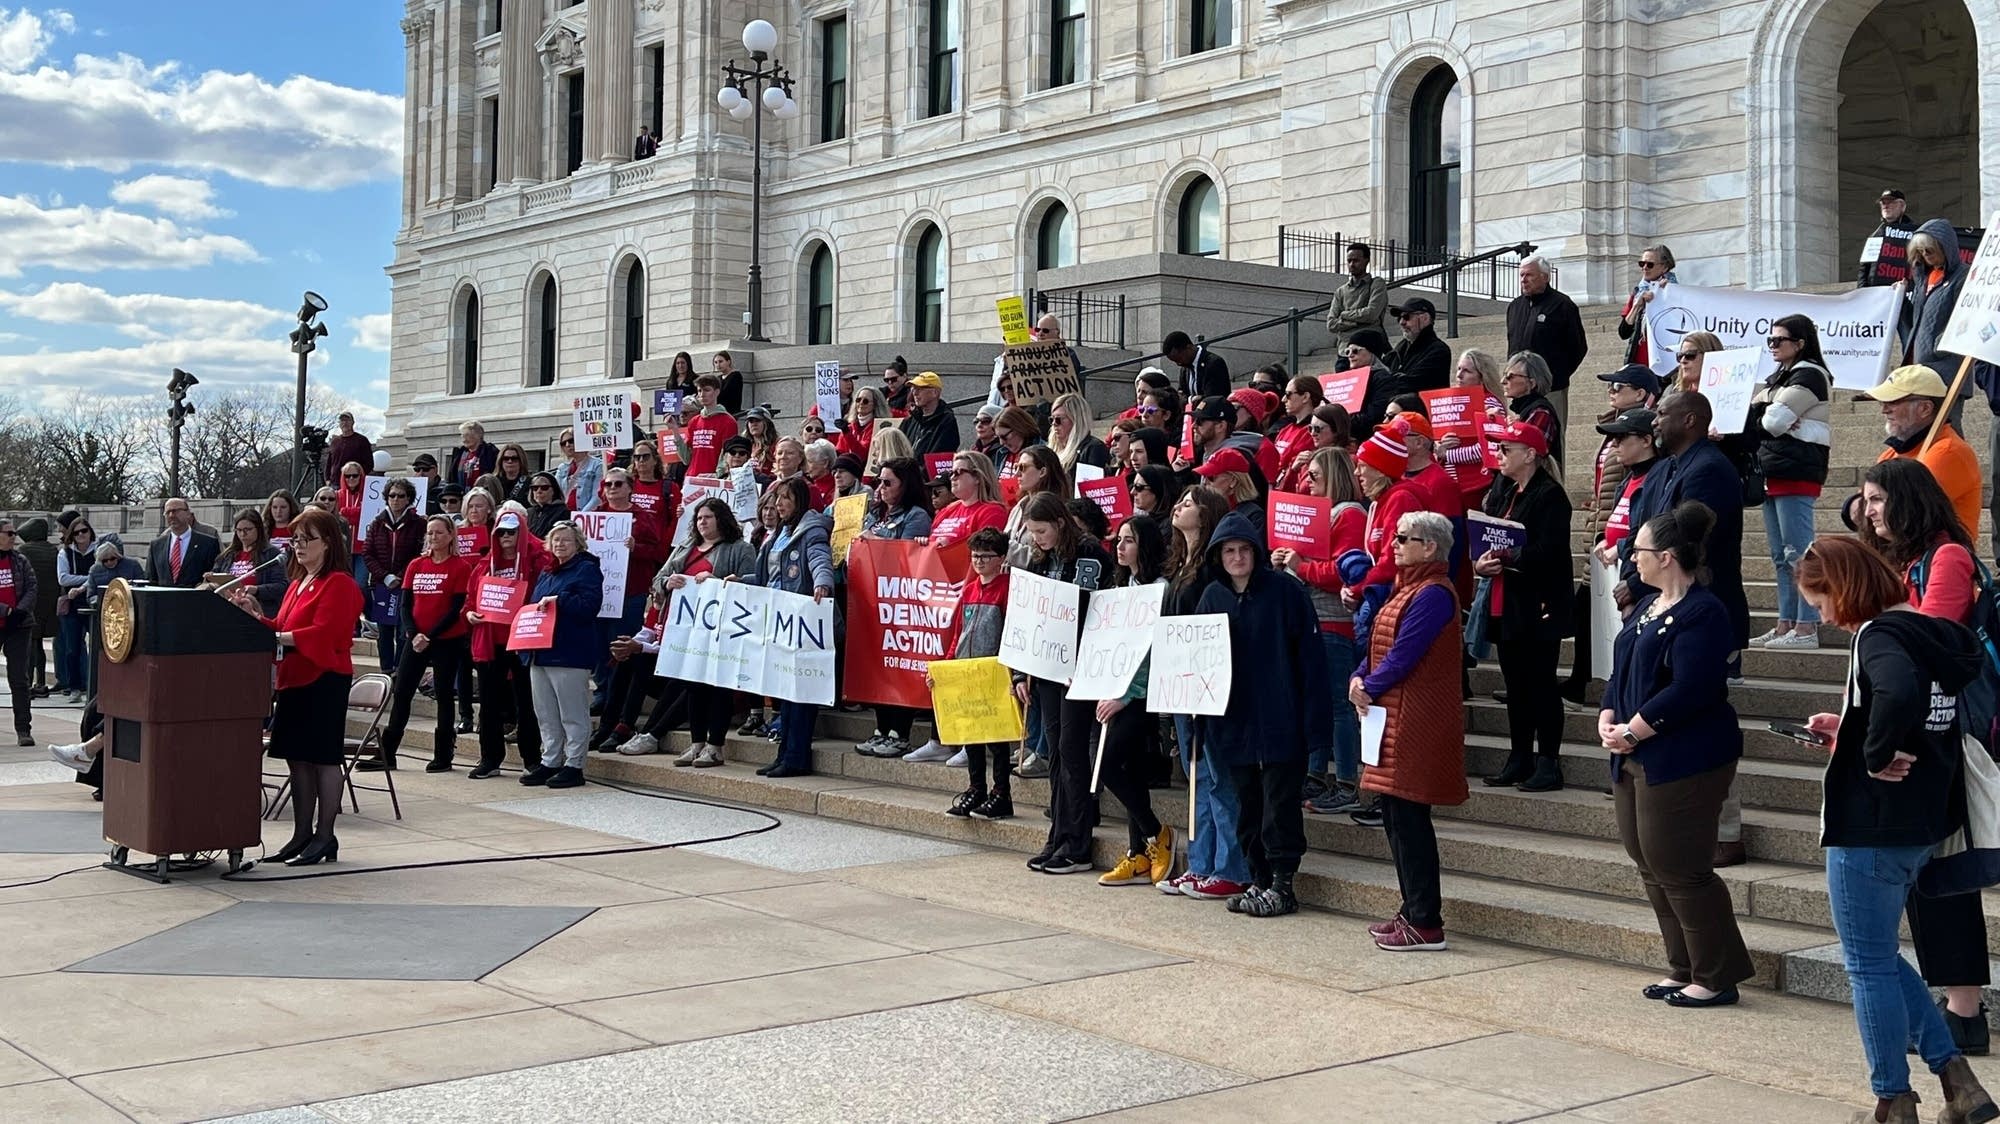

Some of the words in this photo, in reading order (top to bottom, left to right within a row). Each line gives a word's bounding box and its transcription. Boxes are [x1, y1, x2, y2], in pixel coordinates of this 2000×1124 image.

[1885, 226, 1913, 239] Vetera
[1882, 243, 1905, 258] Ban
[1877, 263, 1905, 281] Stop
[1704, 316, 1749, 338] Unity
[1007, 341, 1069, 361] THOUGHTS
[818, 368, 839, 377] KIDS
[1011, 359, 1068, 379] PRAYERS
[818, 377, 838, 388] NOT
[1017, 376, 1078, 399] ACTION
[818, 388, 839, 396] GUNS
[1324, 385, 1354, 395] DEMAND
[573, 398, 584, 409] #1
[587, 395, 611, 408] CAUSE
[614, 395, 623, 405] OF
[1431, 397, 1453, 407] MOMS
[1715, 390, 1744, 411] HATE
[580, 409, 603, 422] DEATH
[608, 408, 622, 419] FOR
[1431, 404, 1465, 415] DEMAND
[1432, 412, 1460, 423] ACTION
[585, 421, 609, 435] KIDS
[614, 422, 622, 432] IS
[1276, 502, 1300, 513] MOMS
[1275, 512, 1311, 525] DEMAND
[573, 514, 606, 541] ONE
[1274, 522, 1304, 535] ACTION
[1485, 526, 1508, 537] TAKE
[1481, 533, 1514, 546] ACTION
[1490, 543, 1509, 551] NOT
[877, 575, 933, 601] MOMS
[481, 591, 510, 601] DEMAND
[1051, 583, 1076, 623] Laws
[480, 599, 504, 608] ACTION
[517, 618, 543, 627] DEMAND
[878, 602, 954, 629] DEMAND
[515, 625, 538, 634] ACTION
[772, 610, 826, 650] MN
[1166, 623, 1222, 645] PROTECT
[882, 628, 945, 656] ACTION
[1032, 624, 1070, 665] Crime
[884, 656, 899, 668] FOR
[900, 657, 911, 670] GUN
[1077, 644, 1111, 679] NOT
[1189, 643, 1224, 673] KIDS
[774, 663, 826, 678] MINNESOTA
[1157, 672, 1195, 708] NOT
